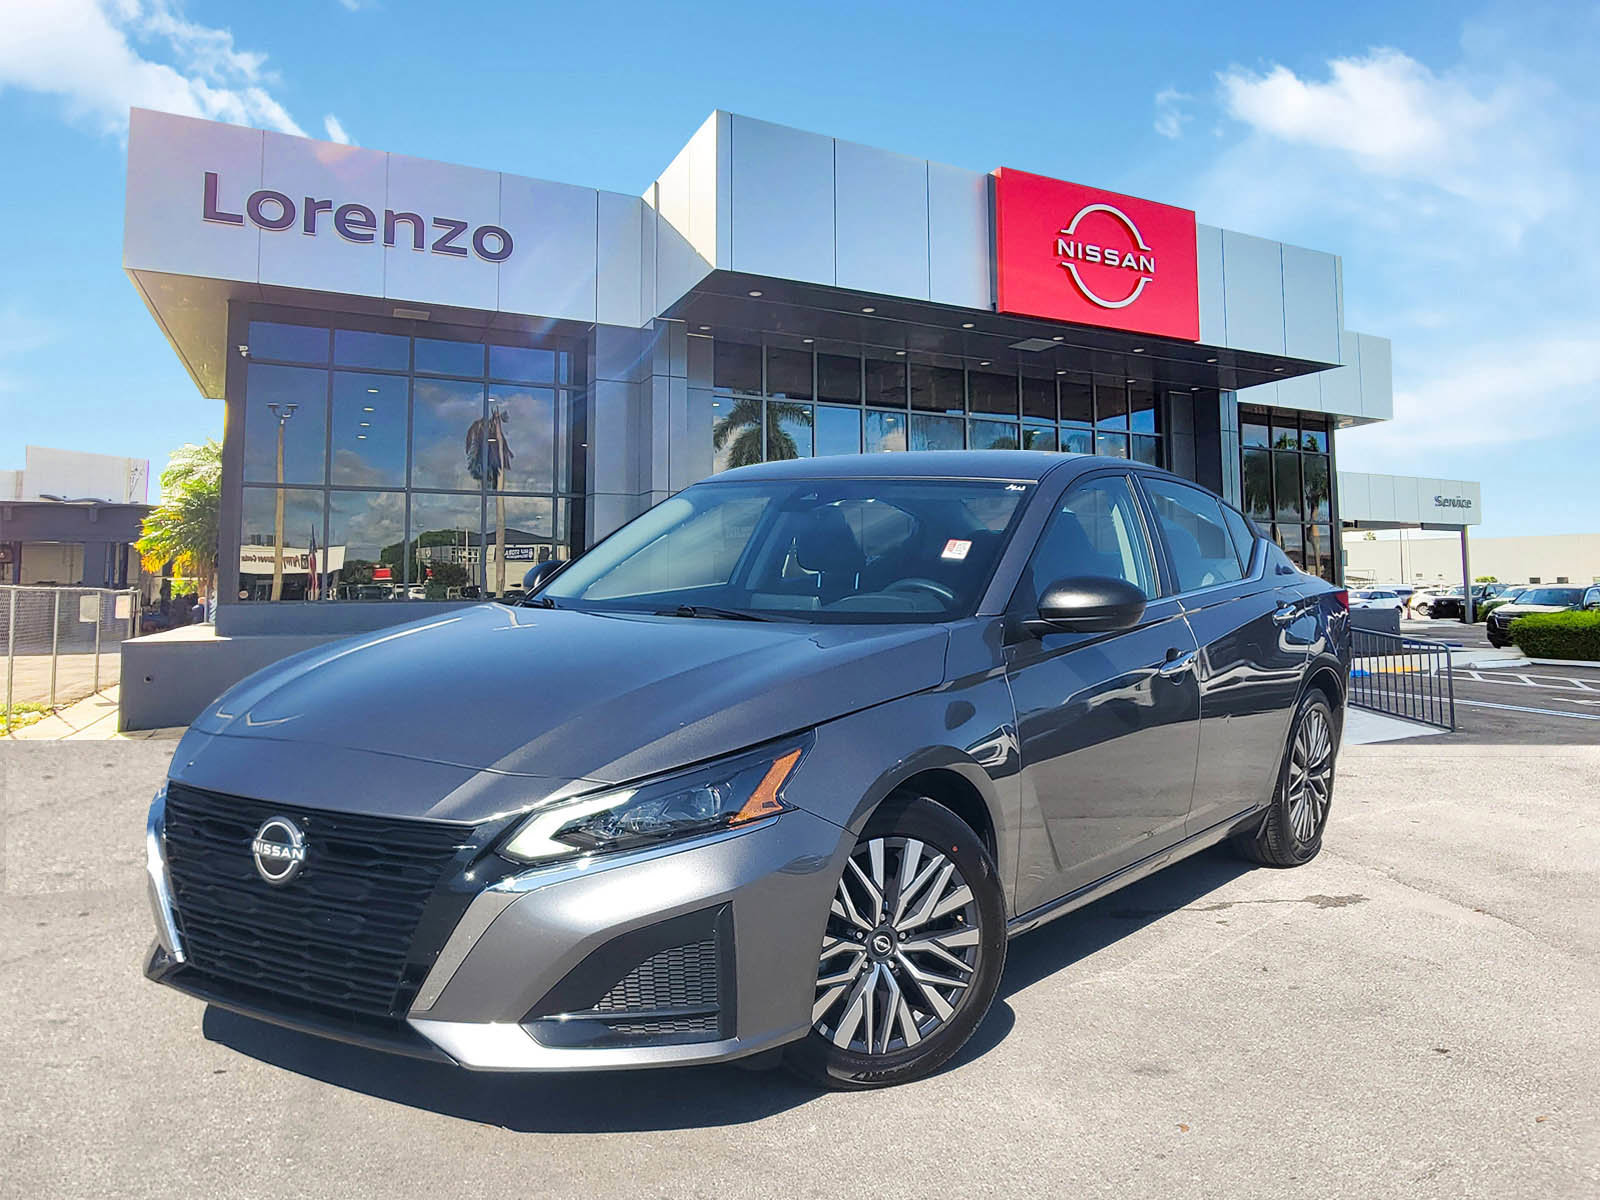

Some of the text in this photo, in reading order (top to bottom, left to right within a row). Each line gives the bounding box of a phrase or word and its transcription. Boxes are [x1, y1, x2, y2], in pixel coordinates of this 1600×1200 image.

[203, 171, 514, 262] Lorenzo
[1057, 238, 1155, 273] NISSAN
[1434, 495, 1472, 509] Service
[252, 840, 305, 860] NISSAN
